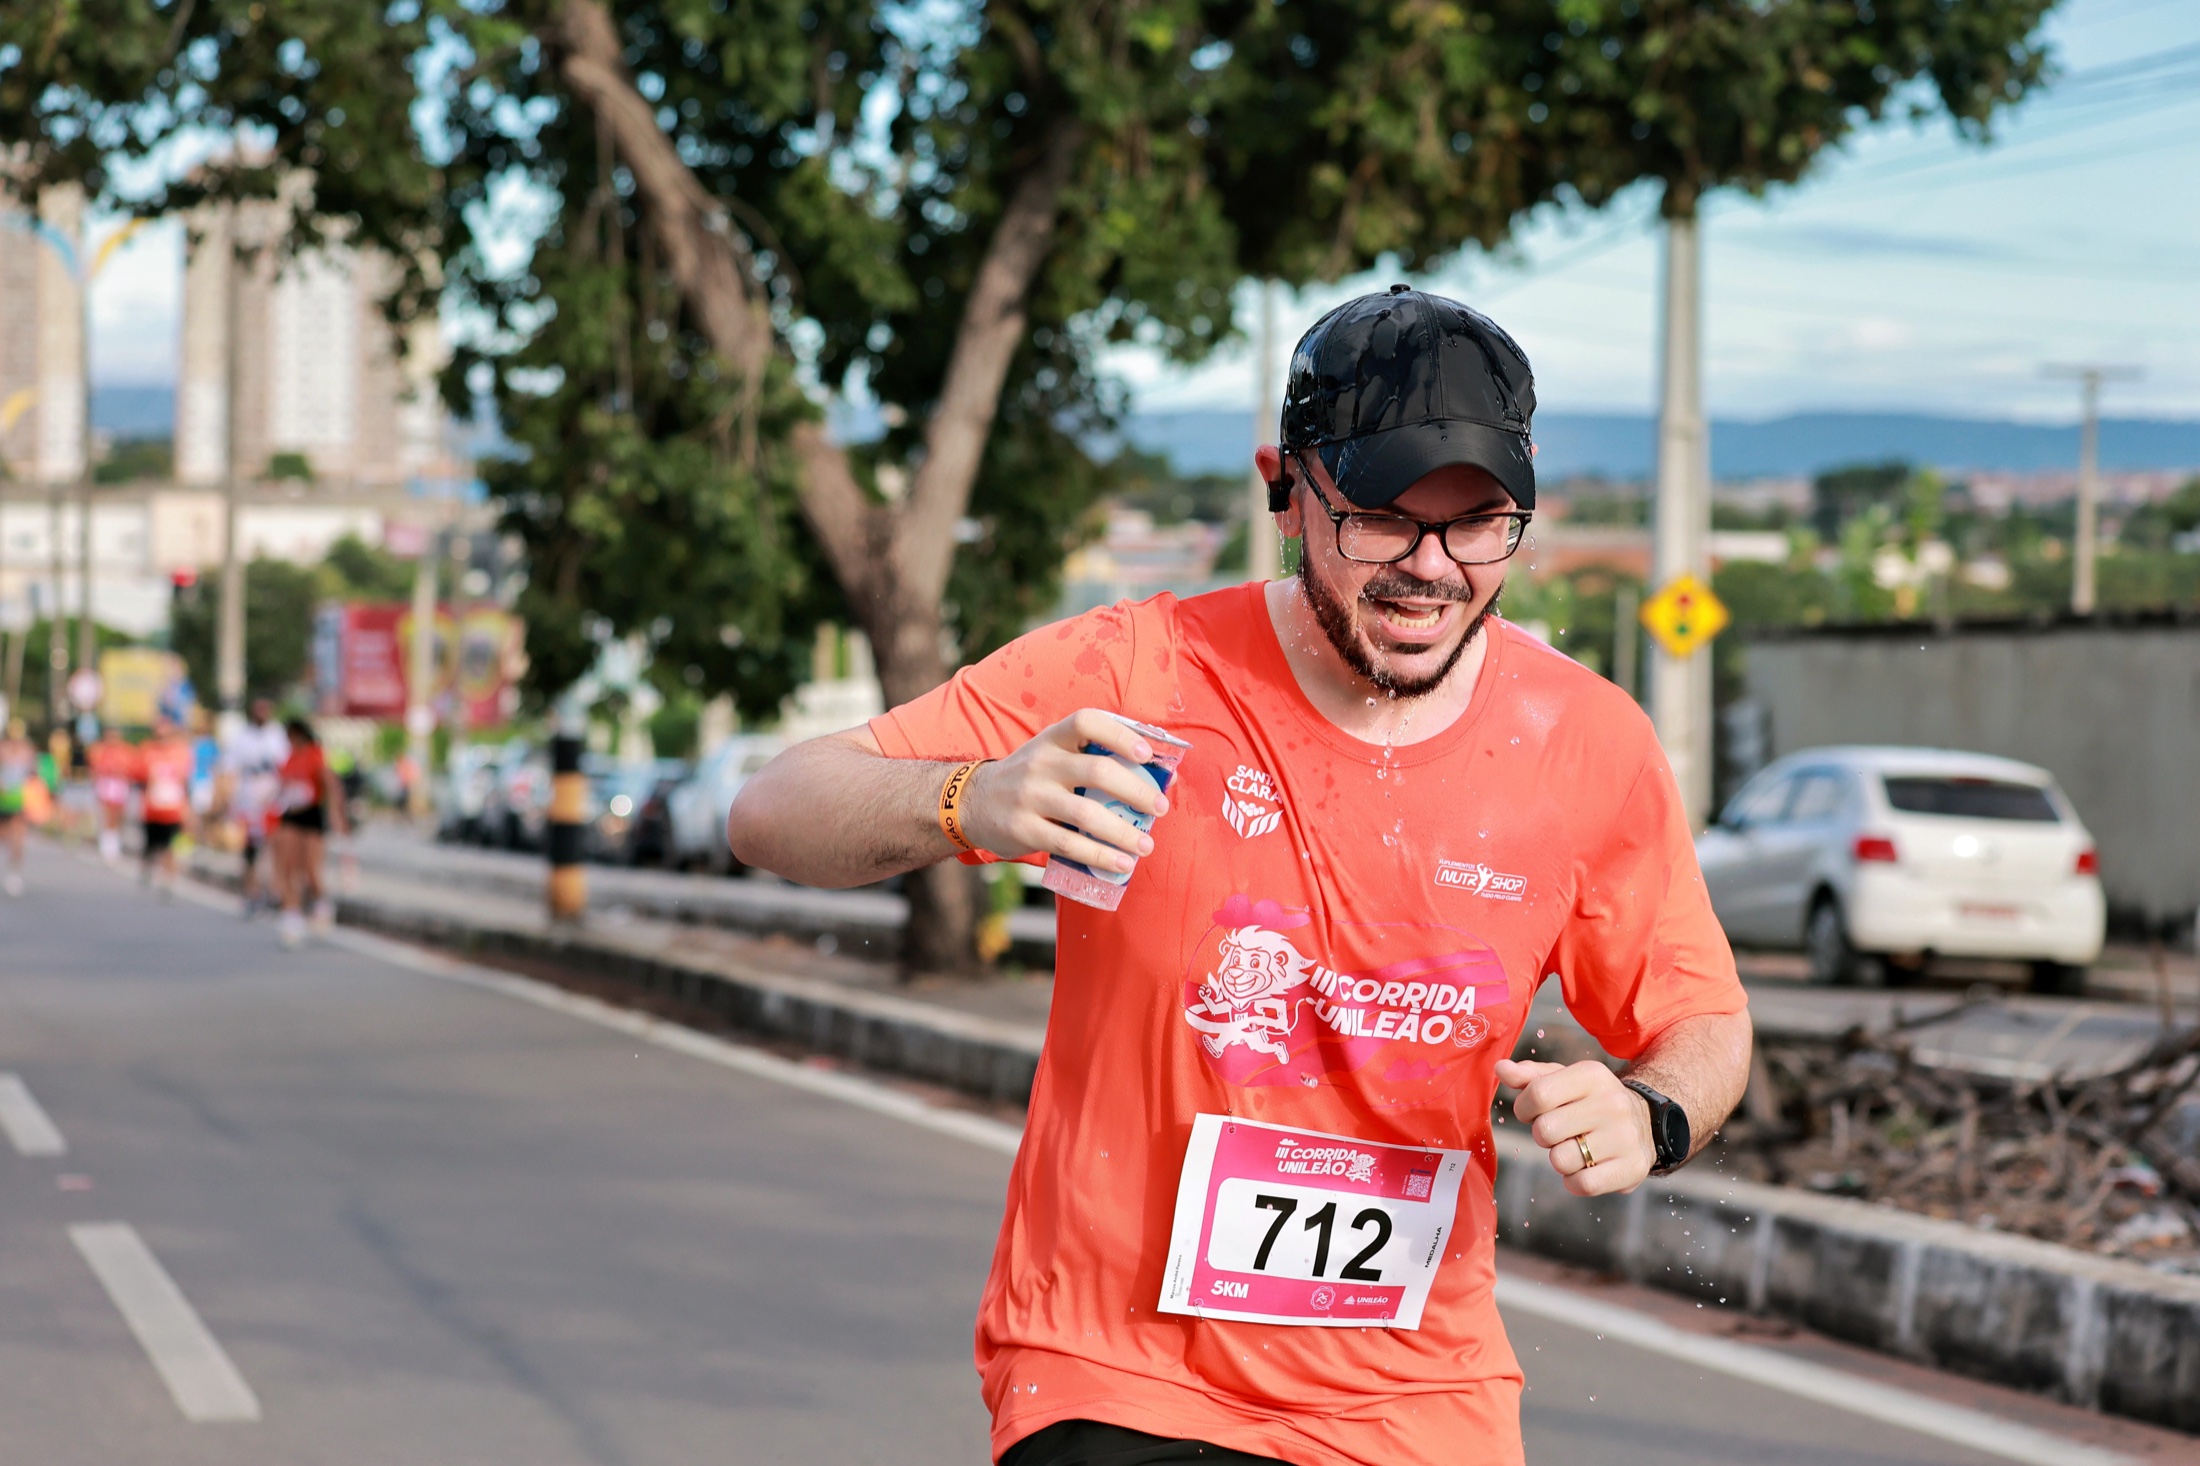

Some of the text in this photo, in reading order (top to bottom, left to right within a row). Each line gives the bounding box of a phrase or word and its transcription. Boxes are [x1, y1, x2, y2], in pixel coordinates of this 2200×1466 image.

[1227, 775, 1283, 804] CLARA
[1490, 876, 1523, 891] SHOP
[1337, 975, 1476, 1015] CORRIDA
[1314, 997, 1453, 1045] UNILEÃO
[1459, 1021, 1479, 1038] 25
[1275, 1146, 1358, 1162] III CORRIDA
[1277, 1158, 1347, 1176] UNILEÃO
[1253, 1194, 1393, 1282] 712
[1424, 1226, 1442, 1268] MEDALHA
[1210, 1280, 1249, 1299] 5KM
